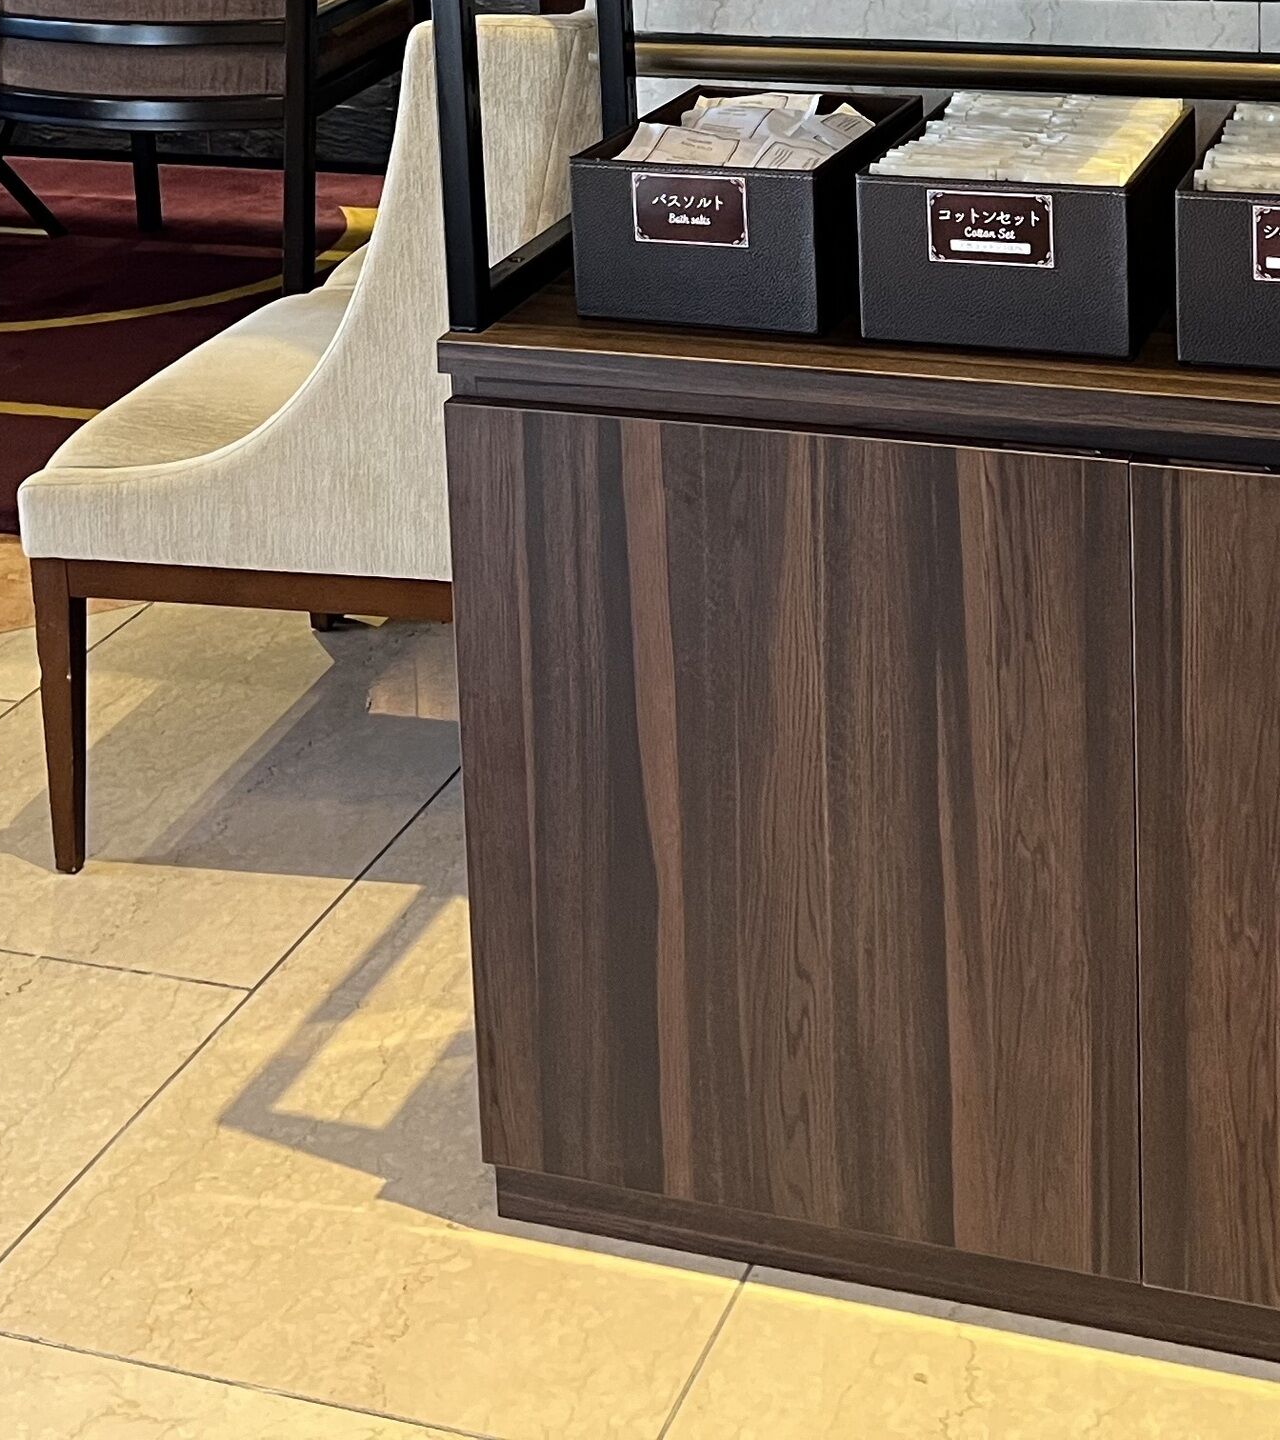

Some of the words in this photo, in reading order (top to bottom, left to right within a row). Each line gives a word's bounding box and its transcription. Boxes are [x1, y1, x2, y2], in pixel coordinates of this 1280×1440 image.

[668, 212, 690, 225] Bath
[938, 207, 1040, 228] コットンセット
[964, 226, 996, 239] Cotton
[997, 227, 1016, 240] Set
